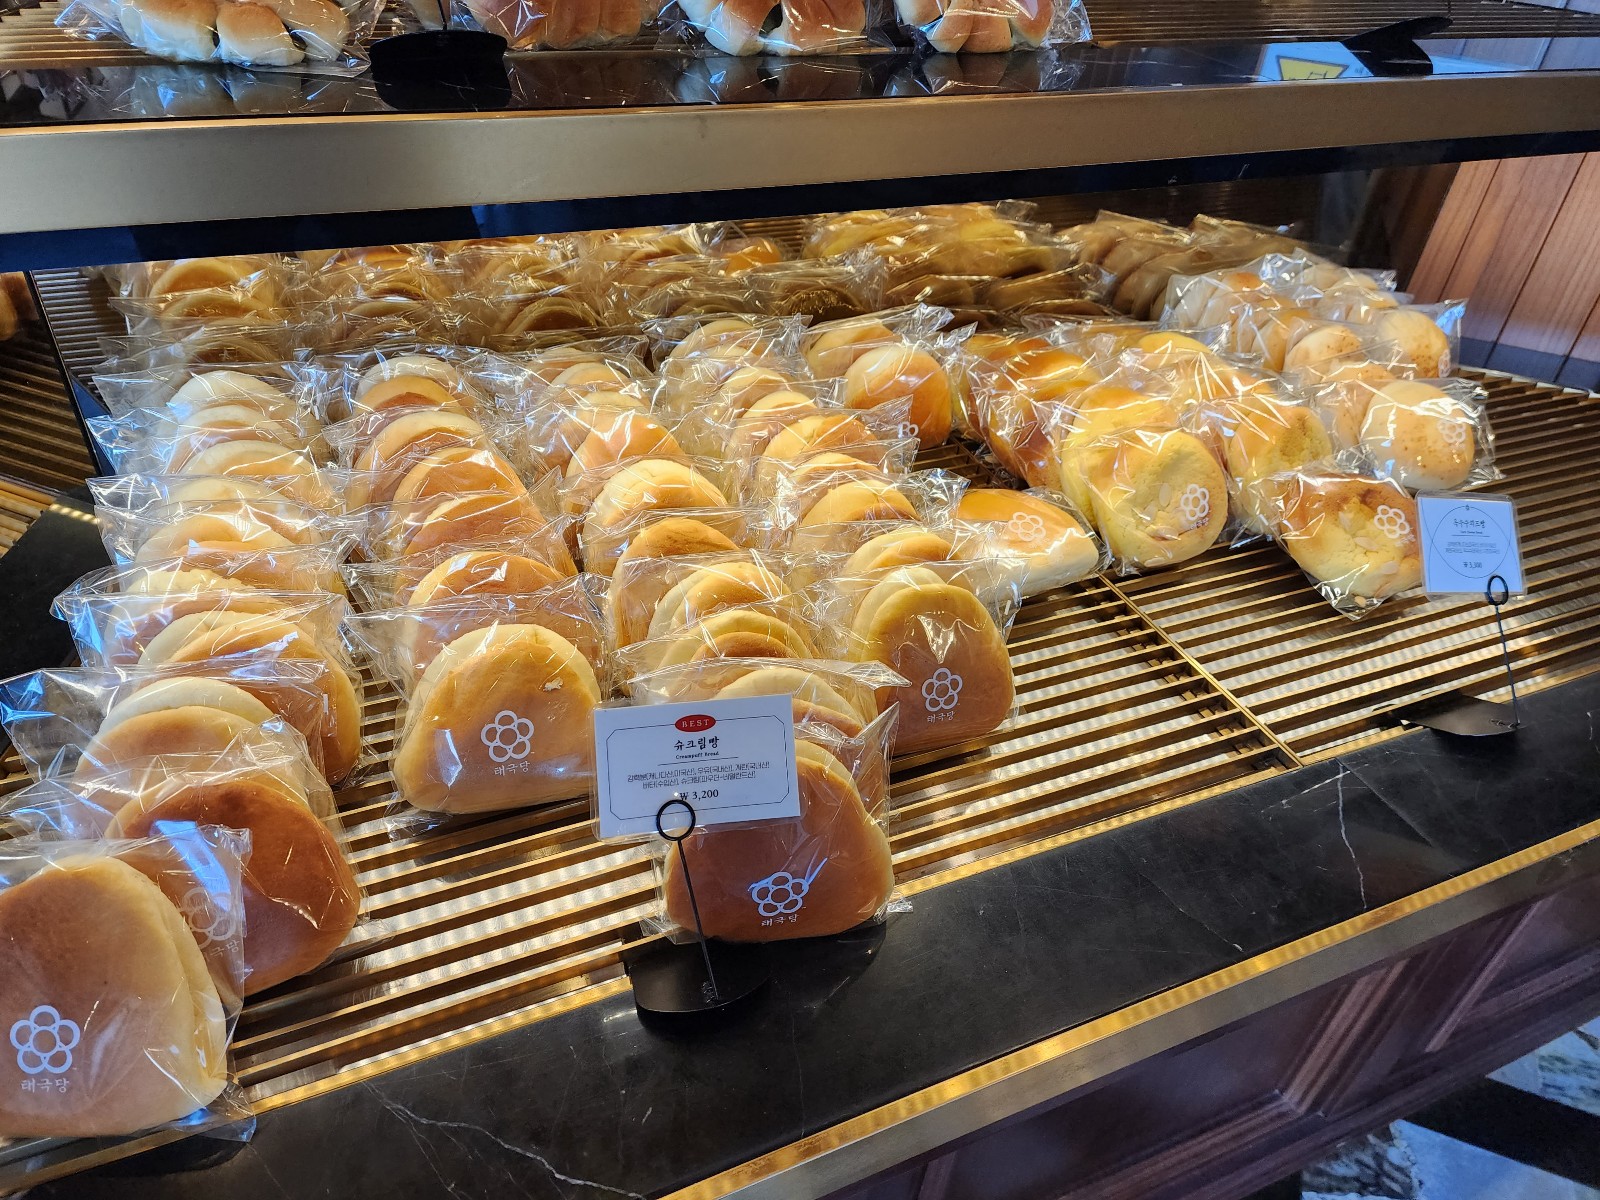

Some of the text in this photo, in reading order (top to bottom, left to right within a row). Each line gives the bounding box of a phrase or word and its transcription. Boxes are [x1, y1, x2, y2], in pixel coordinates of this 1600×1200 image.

[682, 719, 710, 728] BEST
[927, 710, 955, 723] 태극당
[674, 736, 720, 751] 슈크림빵
[494, 760, 530, 776] 태극당
[692, 789, 719, 802] 3,200
[761, 913, 800, 927] 태극당
[21, 1077, 70, 1093] 태극당
